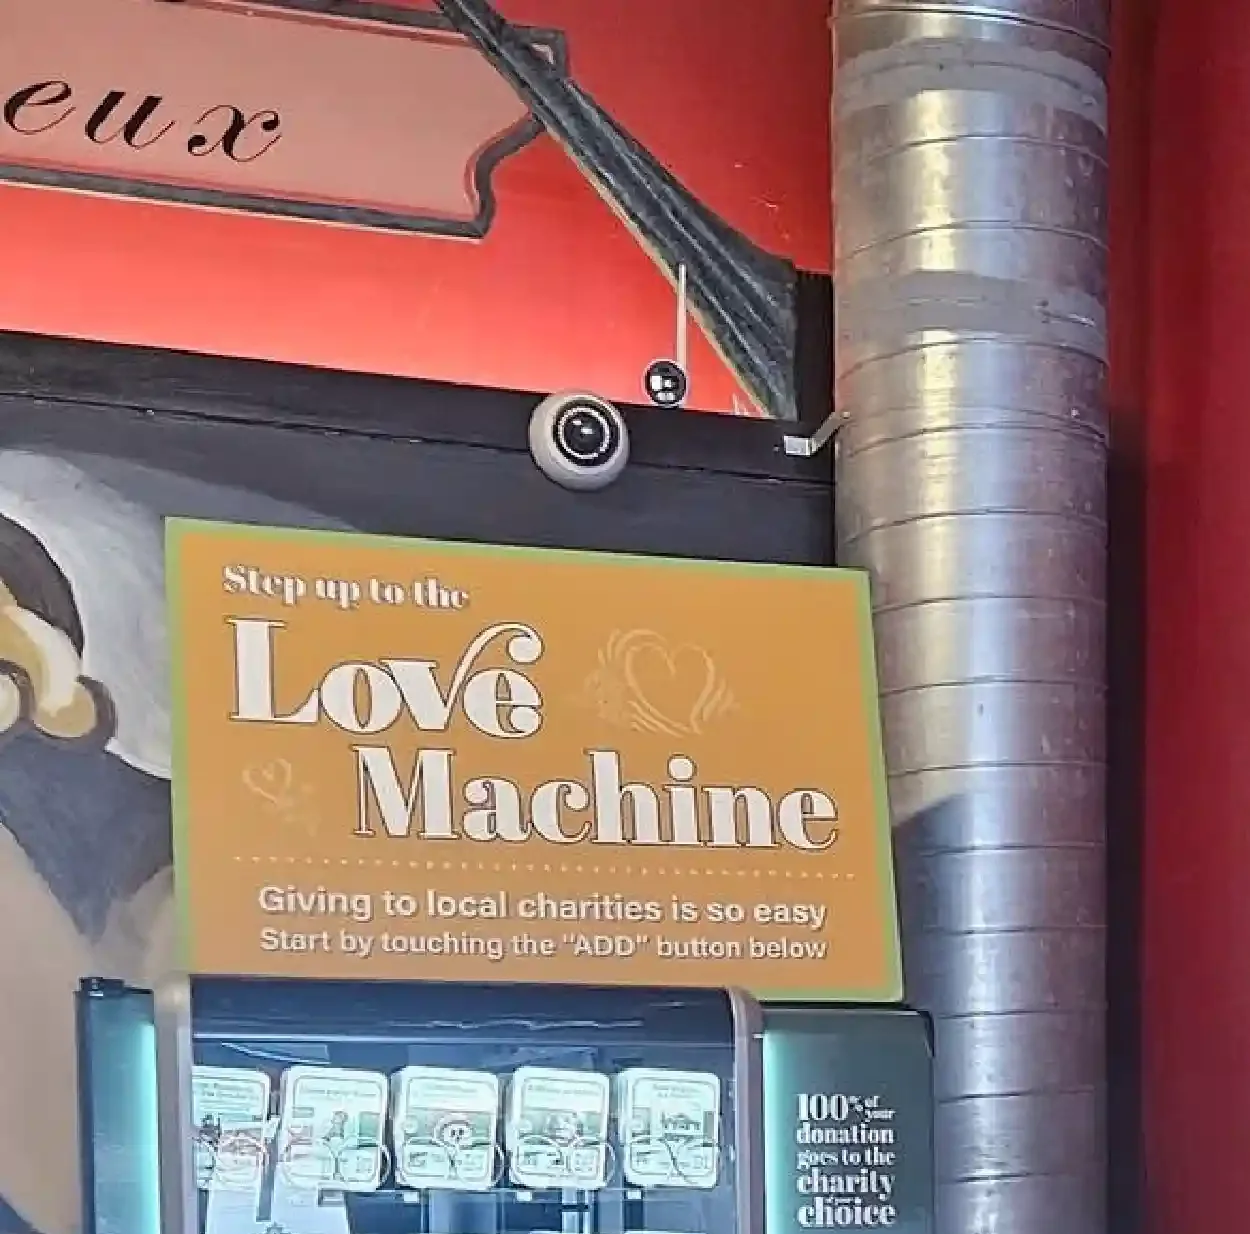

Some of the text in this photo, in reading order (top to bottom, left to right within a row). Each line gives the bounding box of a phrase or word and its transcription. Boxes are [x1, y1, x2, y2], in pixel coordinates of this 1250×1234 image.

[222, 563, 469, 610] Step up to the
[224, 617, 545, 739] Love
[351, 744, 841, 851] Machine
[259, 885, 828, 931] Giving to local charities is so easy
[260, 927, 828, 962] Start by touching the "ADD" button below
[797, 1093, 864, 1121] 100%
[796, 1121, 895, 1144] donation
[797, 1146, 897, 1170] goes to the
[797, 1167, 897, 1201] charity
[798, 1197, 897, 1228] choice
